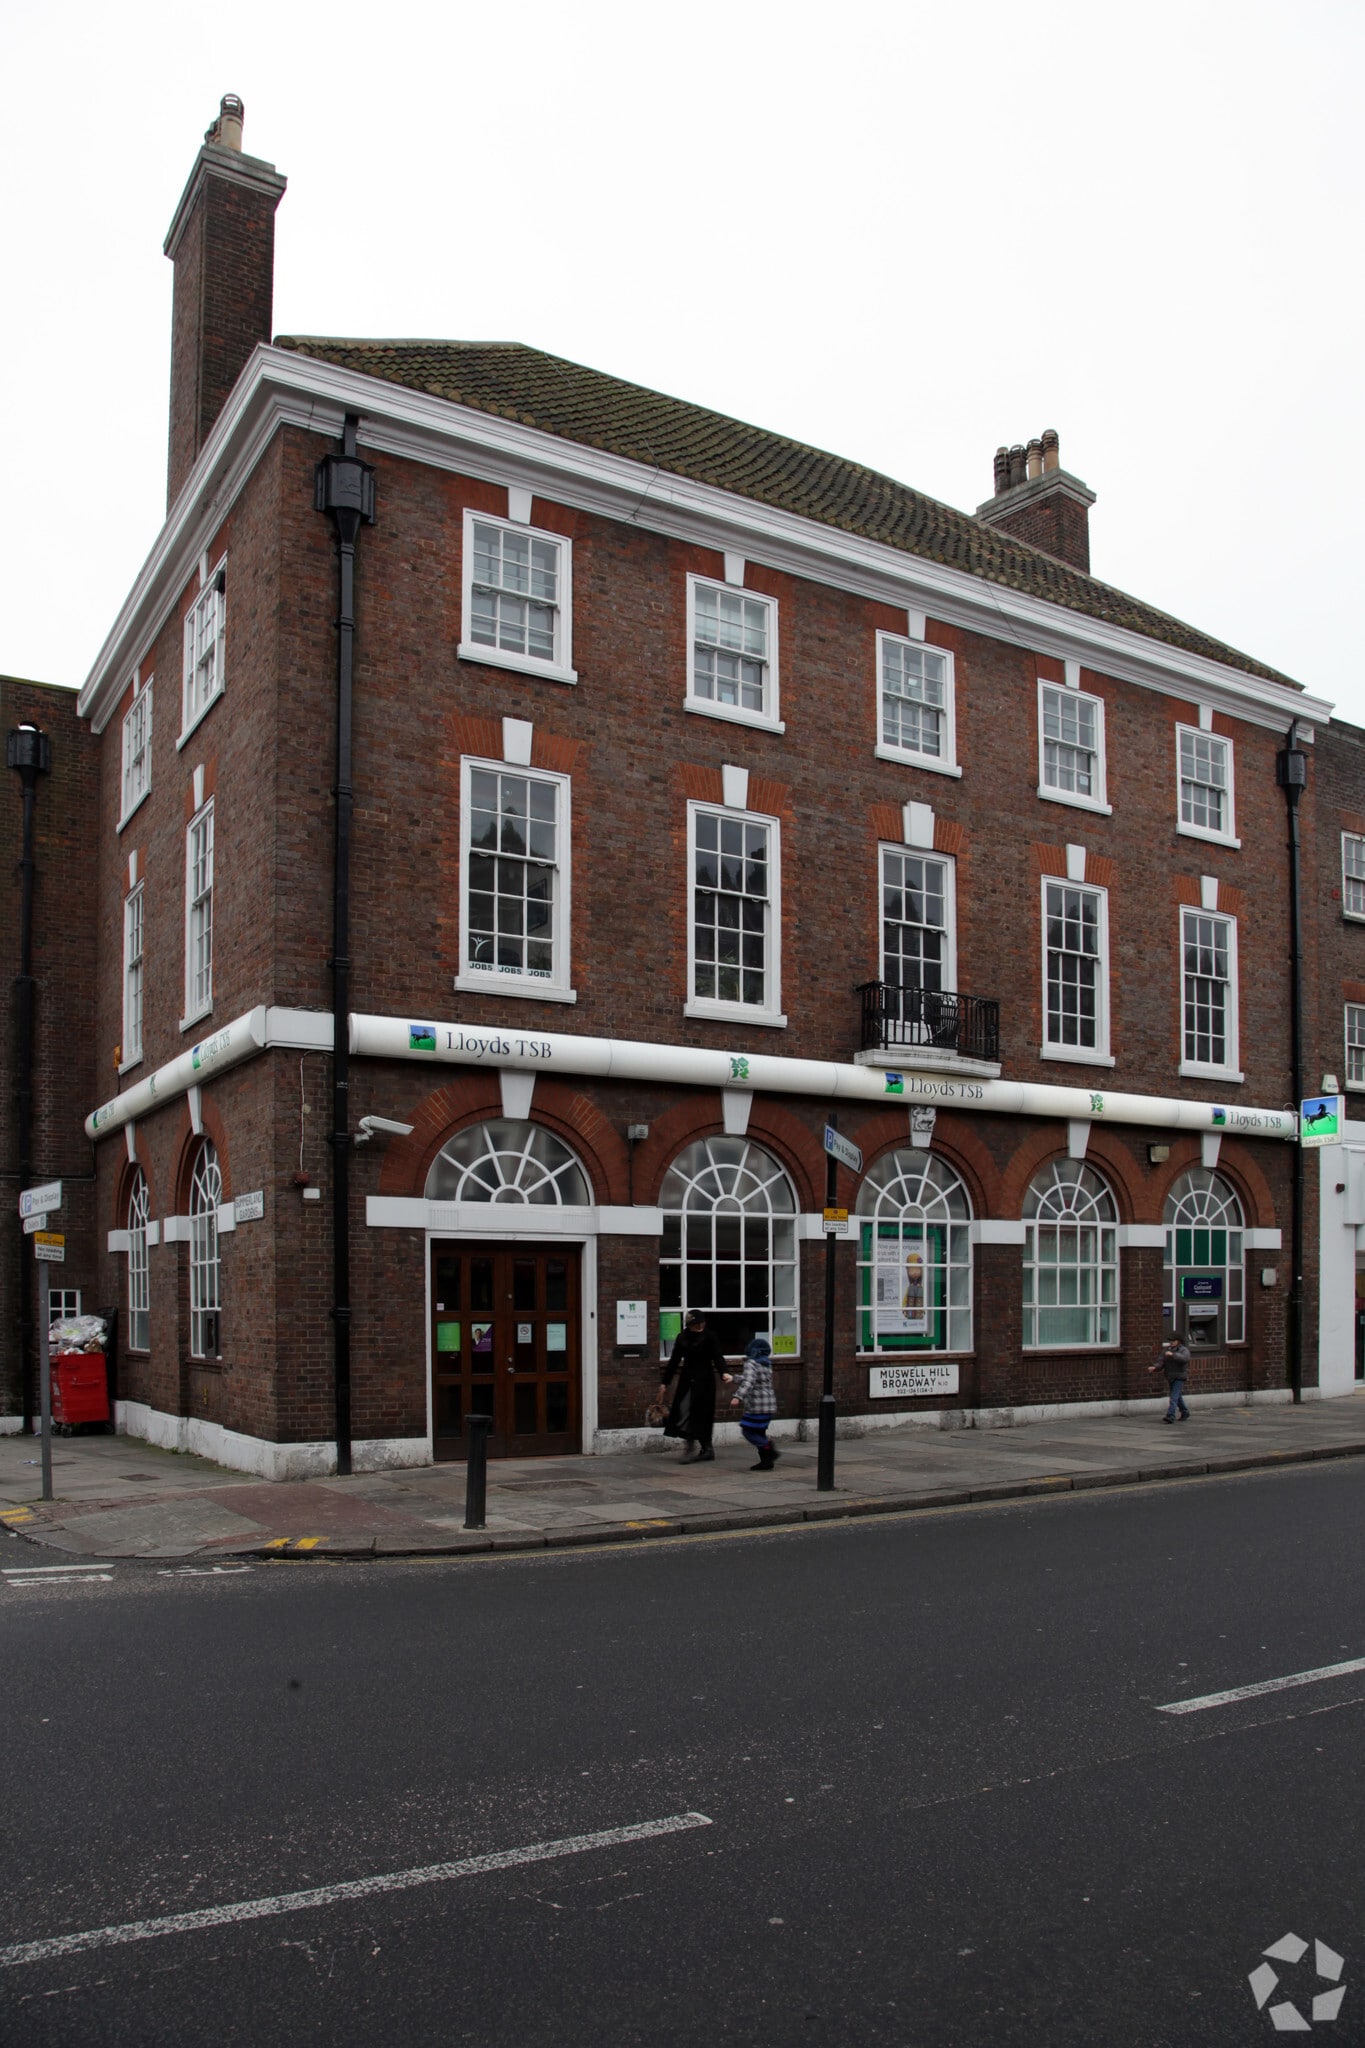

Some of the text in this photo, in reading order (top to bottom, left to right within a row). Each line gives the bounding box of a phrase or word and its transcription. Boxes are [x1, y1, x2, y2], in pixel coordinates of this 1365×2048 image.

[469, 962, 551, 978] JOBS JOBS JOBS
[446, 1031, 552, 1058] Lloyds TSB
[910, 1077, 983, 1100] Lloyds TSB
[1229, 1111, 1282, 1130] Lloyds TSB
[827, 1132, 832, 1147] P
[1305, 1137, 1322, 1146] Lloyds
[25, 1196, 31, 1211] P
[880, 1367, 950, 1379] MUSWELL HILL
[882, 1378, 936, 1388] BROADWAY
